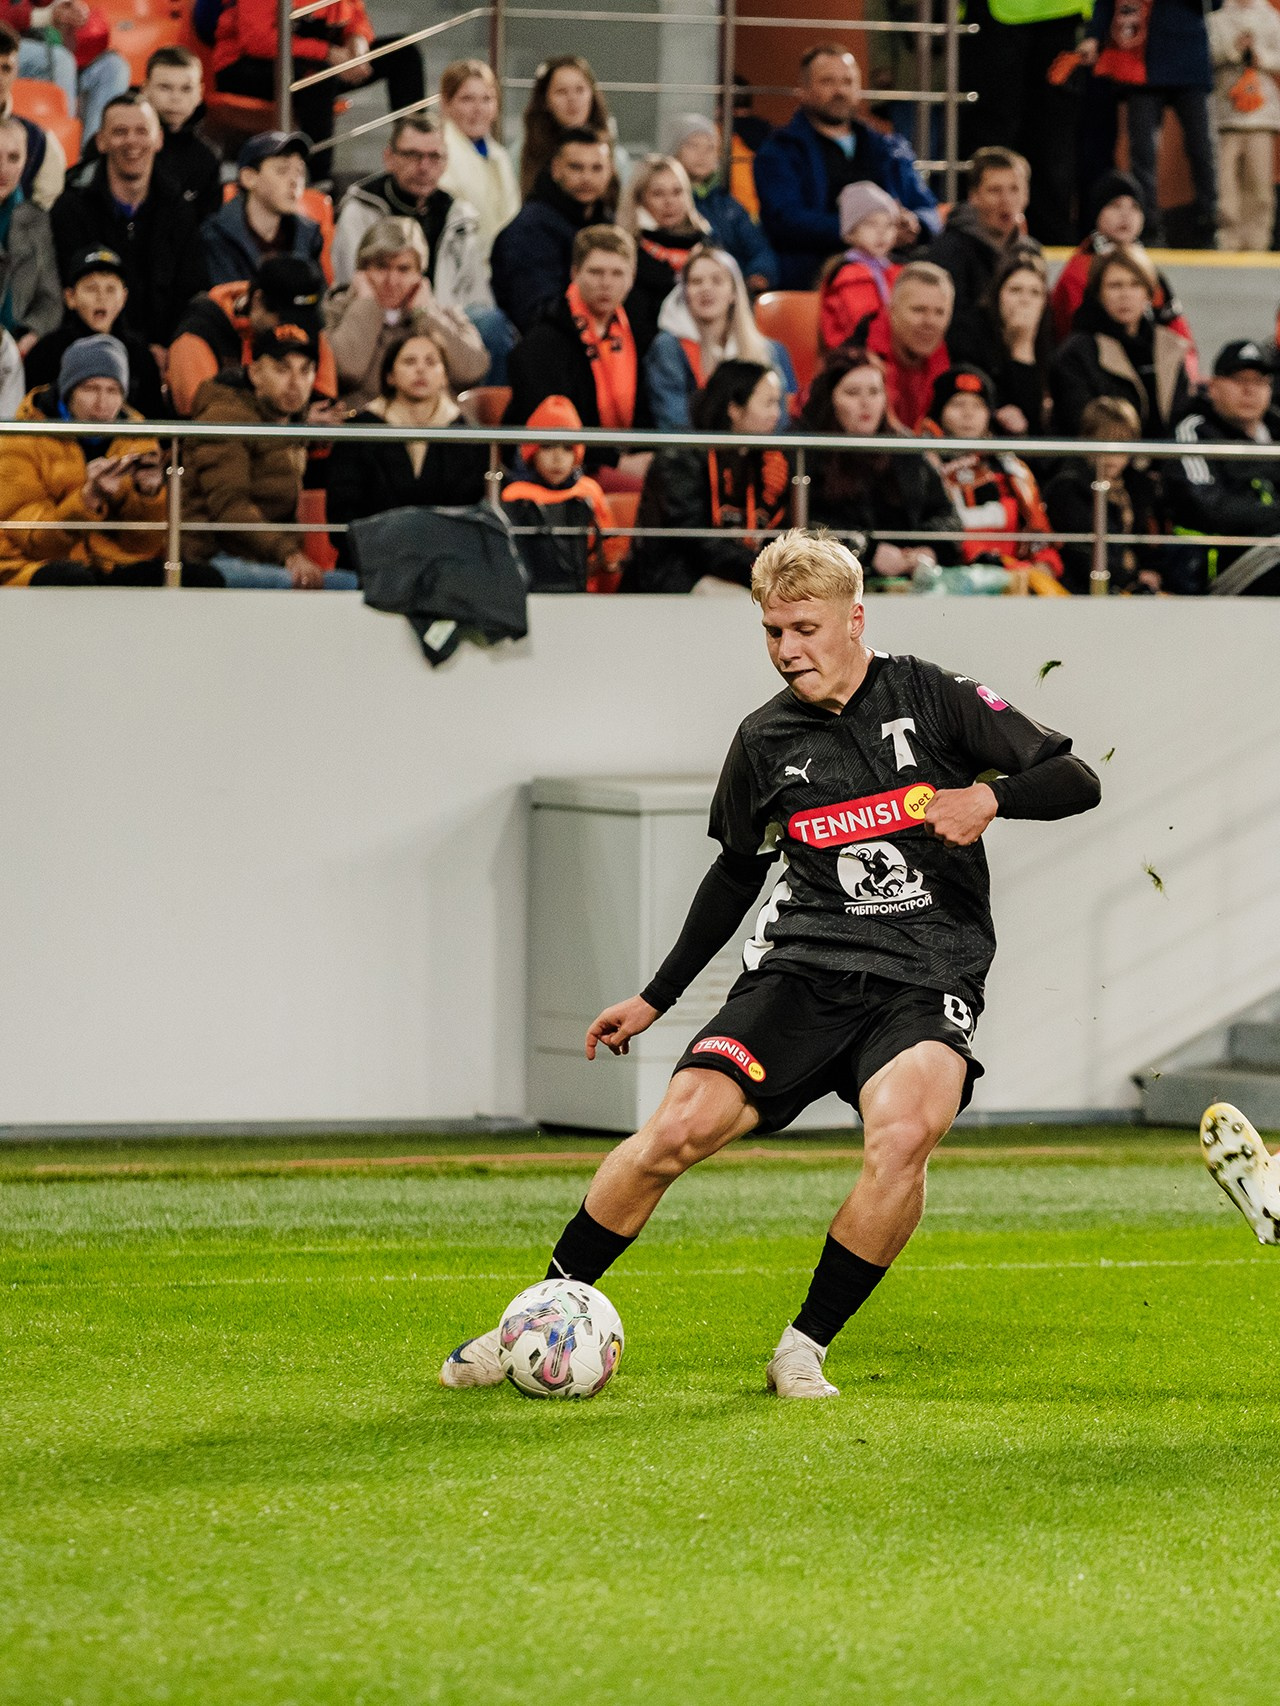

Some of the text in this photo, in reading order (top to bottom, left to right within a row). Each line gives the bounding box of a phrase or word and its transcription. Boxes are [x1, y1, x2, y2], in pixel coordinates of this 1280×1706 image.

[794, 791, 931, 843] TENNISI bet
[845, 894, 933, 916] СИБПРОМСТРОЙ
[697, 1039, 750, 1067] TENNISI
